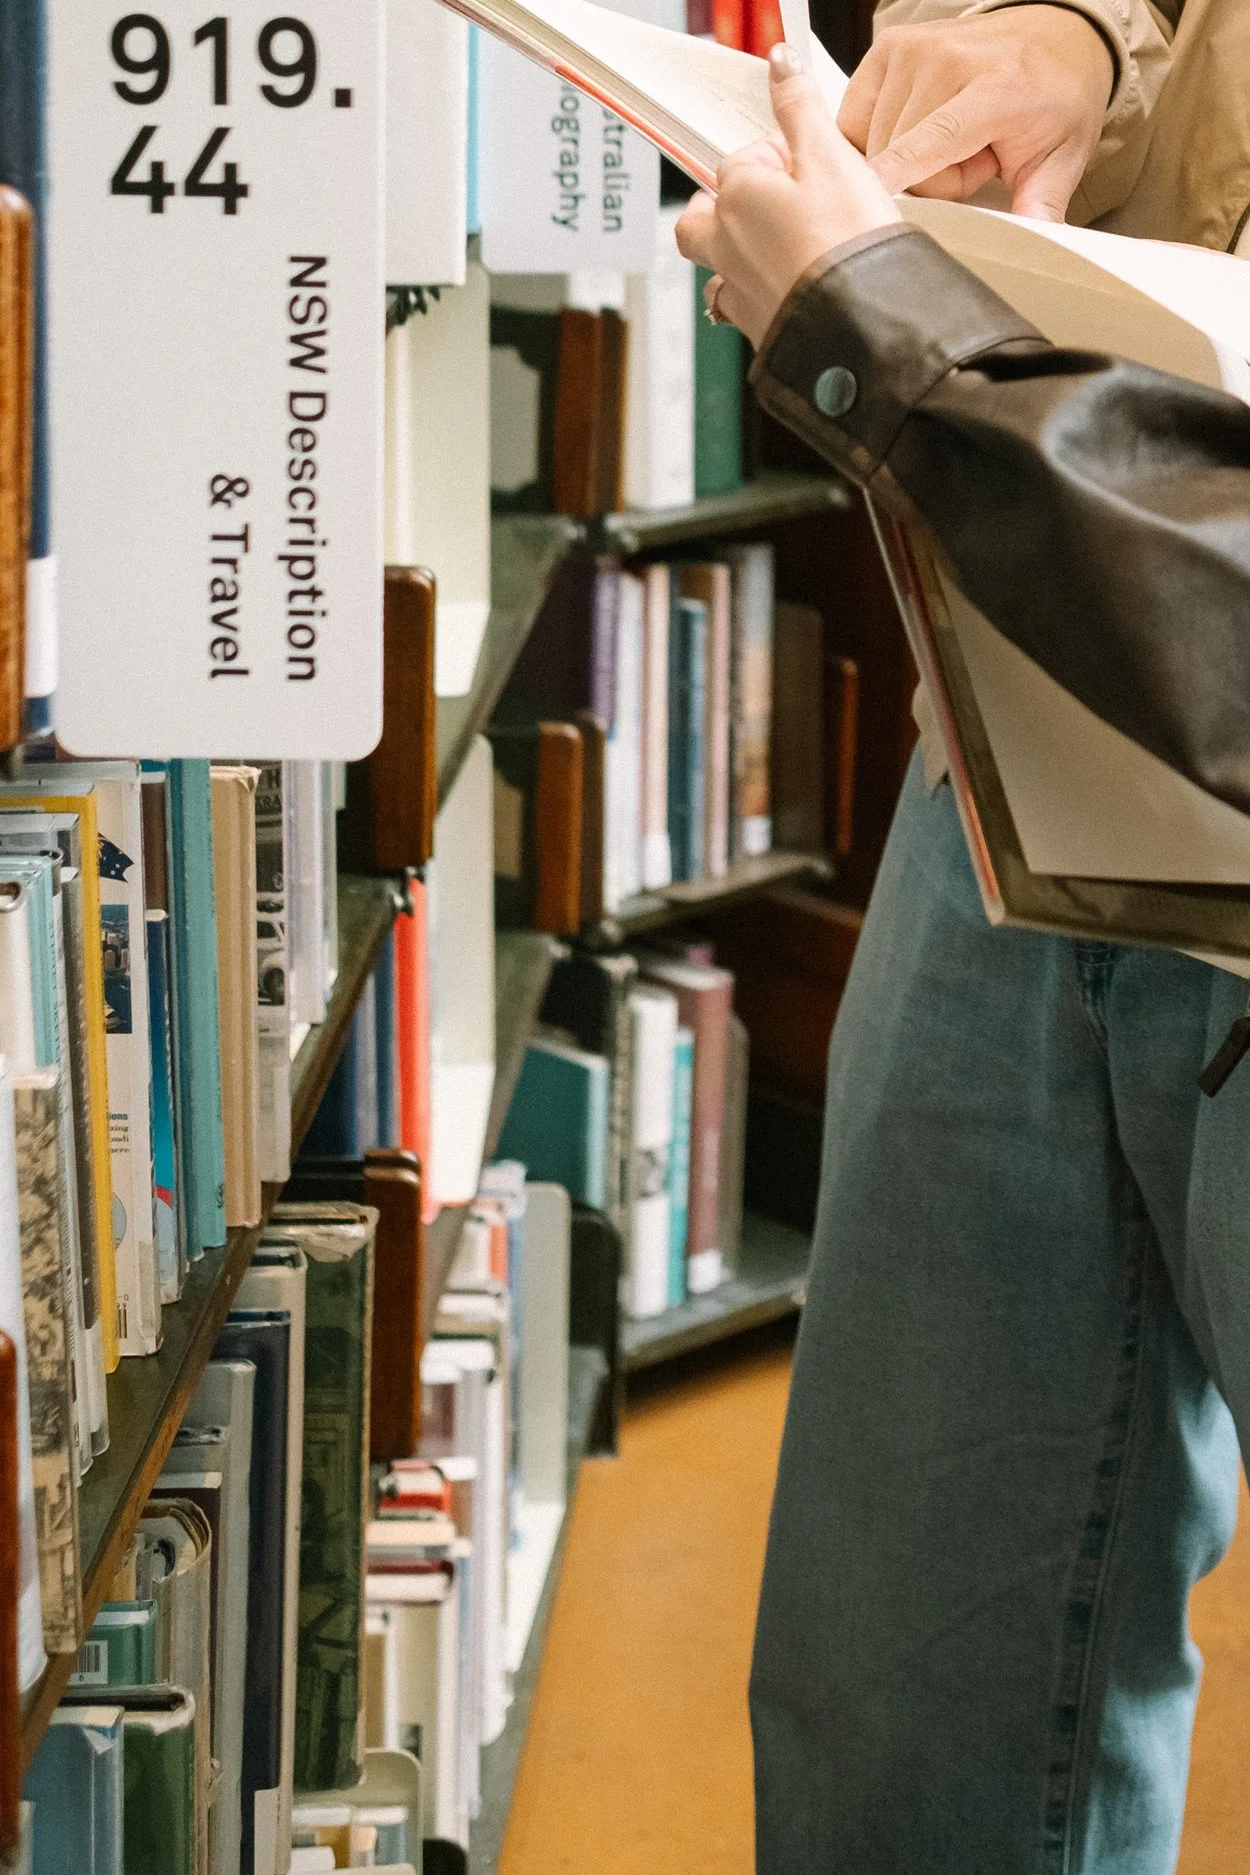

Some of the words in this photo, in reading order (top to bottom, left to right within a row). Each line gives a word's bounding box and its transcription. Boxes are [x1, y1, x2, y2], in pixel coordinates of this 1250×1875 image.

[111, 13, 353, 109] 919.
[111, 125, 250, 216] 44
[551, 82, 585, 232] iography
[602, 110, 630, 233] tralian
[288, 255, 329, 375] NSW
[209, 473, 251, 509] &
[278, 390, 328, 682] Description
[209, 522, 251, 680] Travel
